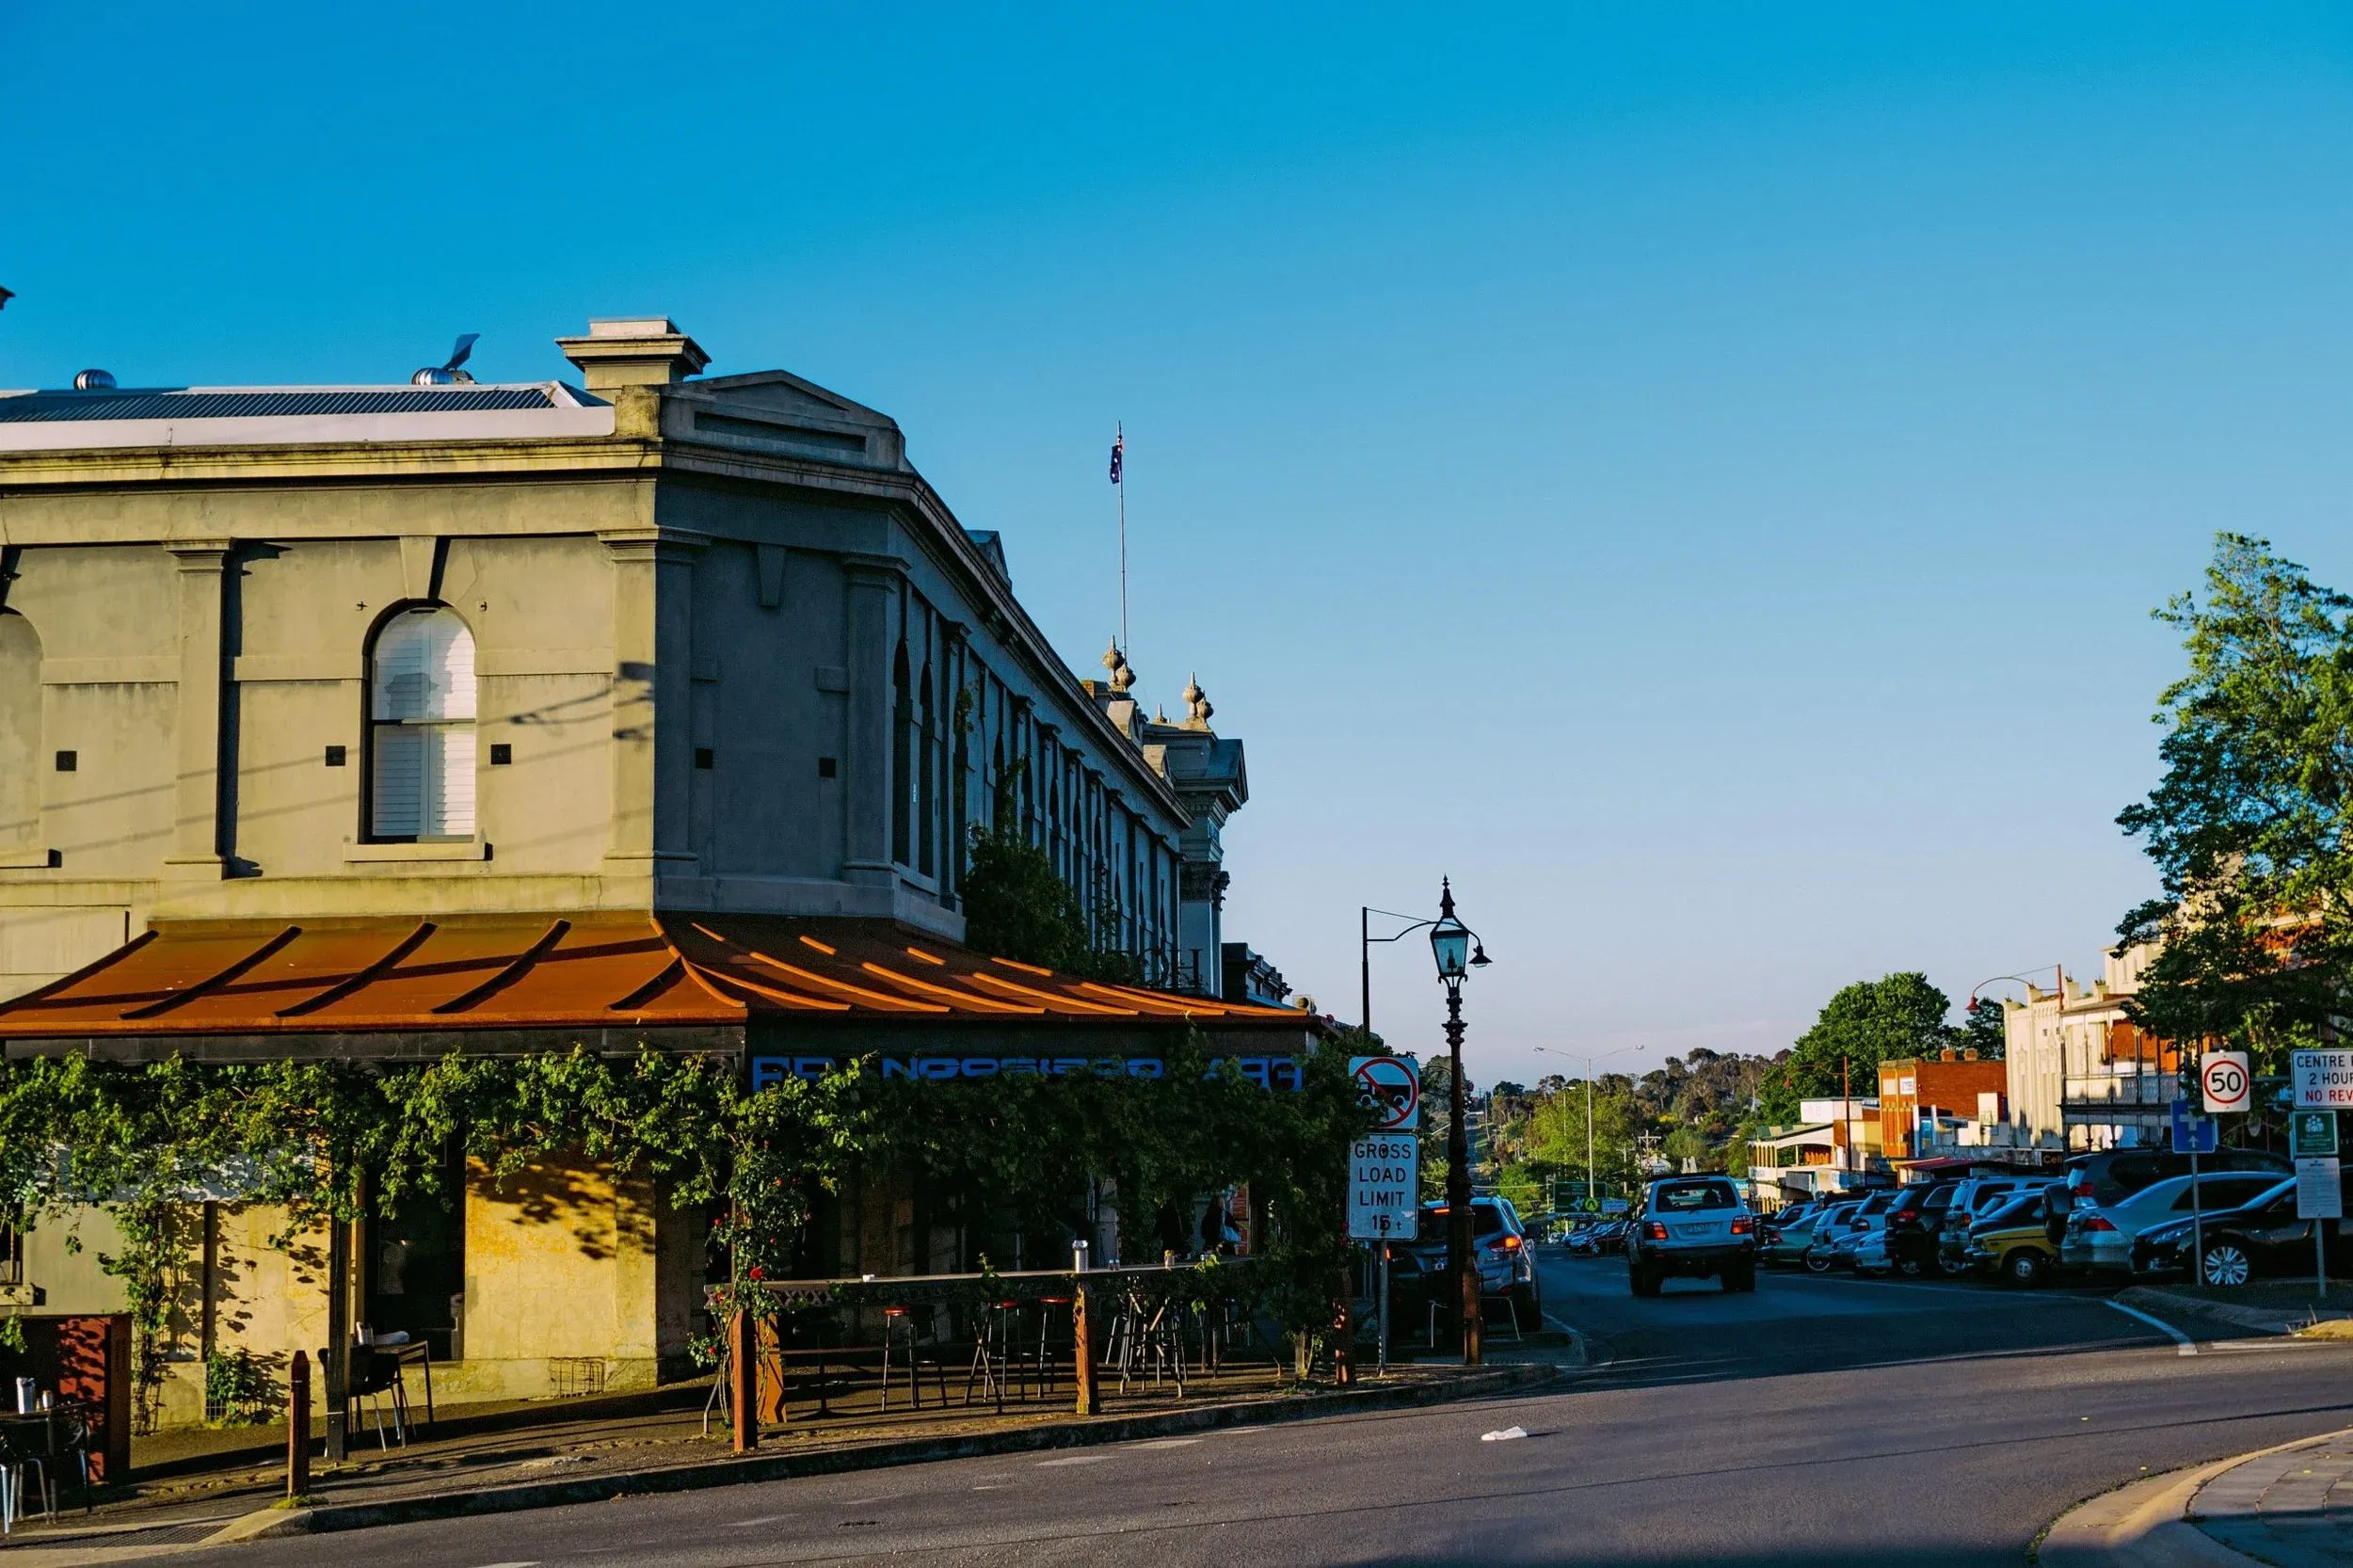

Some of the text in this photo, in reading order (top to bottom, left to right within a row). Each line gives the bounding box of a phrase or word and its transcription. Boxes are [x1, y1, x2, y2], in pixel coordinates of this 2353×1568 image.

[2297, 1055, 2345, 1067] CENTRE
[2212, 1071, 2241, 1092] 50
[2309, 1073, 2316, 1084] 2
[2306, 1090, 2322, 1101] NO
[1355, 1143, 1411, 1159] GROSS
[1359, 1167, 1406, 1182] LOAD
[1360, 1191, 1404, 1207] LIMIT
[1372, 1215, 1401, 1231] 15 t
